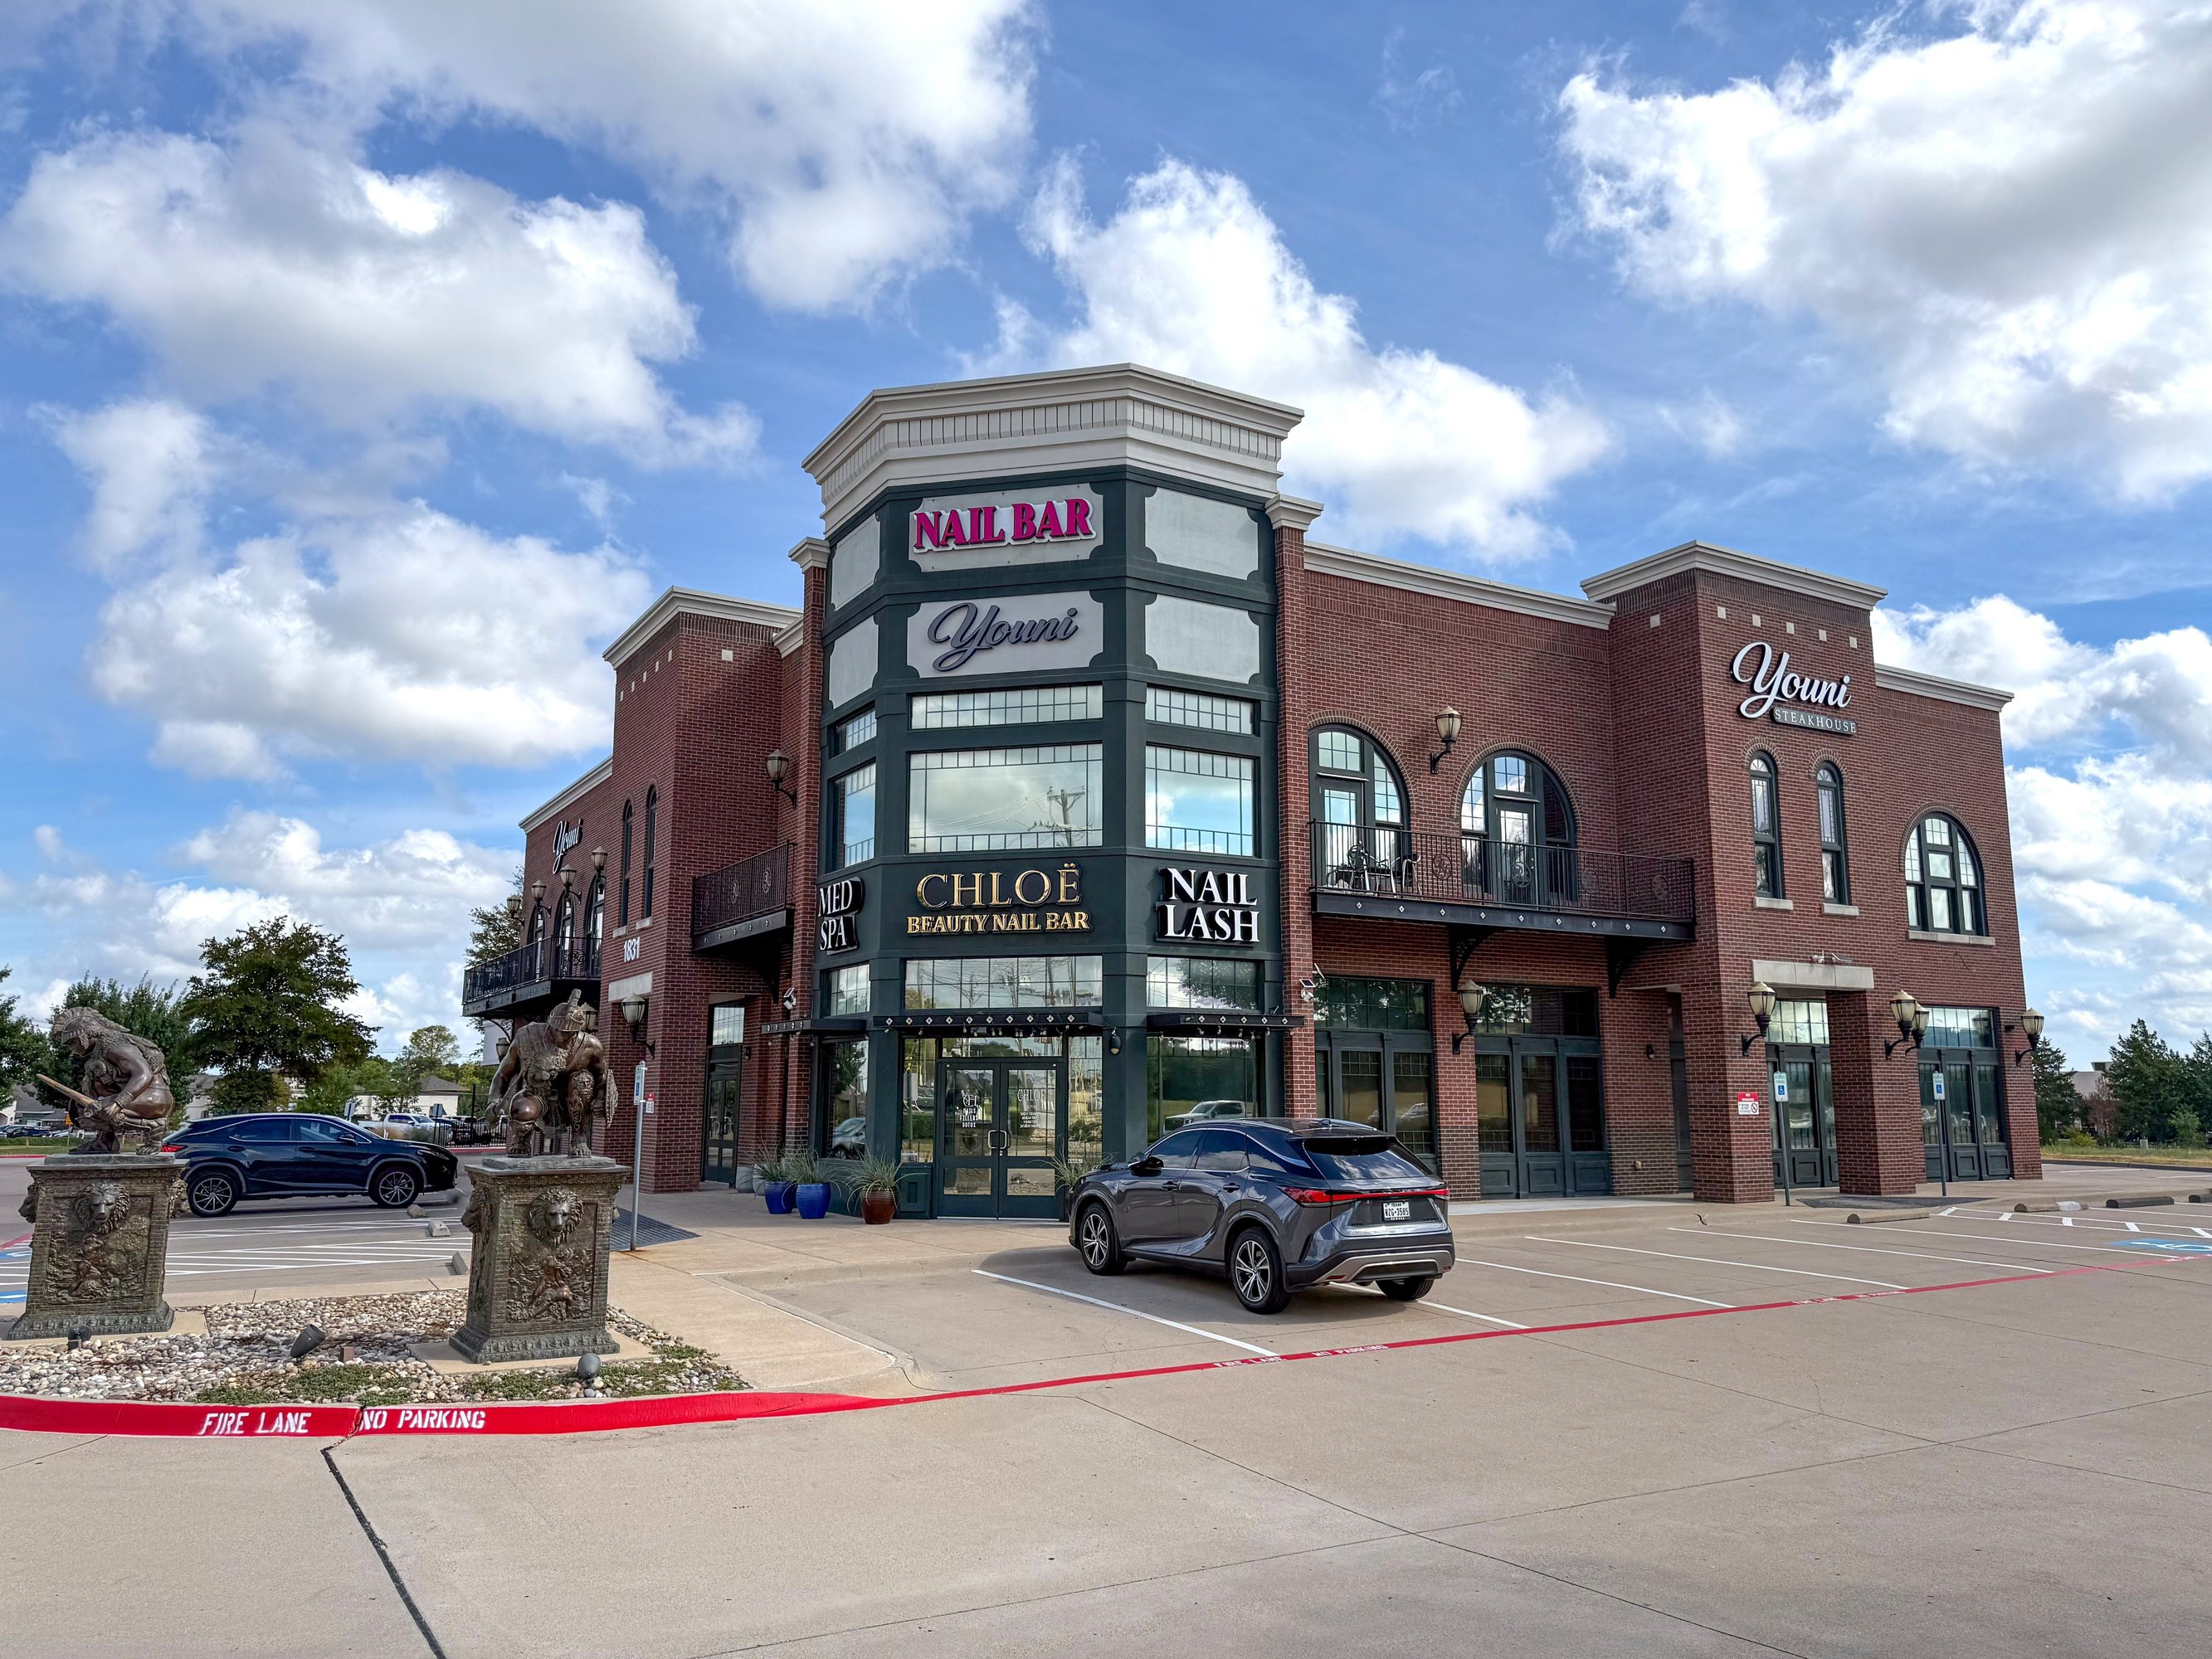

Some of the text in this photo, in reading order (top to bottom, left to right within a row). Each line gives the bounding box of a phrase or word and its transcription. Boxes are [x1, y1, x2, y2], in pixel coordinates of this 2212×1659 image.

[914, 499, 1094, 549] NAIL BAR
[927, 602, 1079, 672] Youni
[1732, 642, 1852, 718] Youni
[1775, 709, 1857, 733] STEAKHOUSE
[818, 879, 853, 917] MED
[916, 863, 1081, 909] CHLOË
[1167, 868, 1258, 906] NAIL
[820, 915, 847, 951] SPA
[907, 912, 1090, 934] BEAUTY NAIL BAR
[1164, 903, 1260, 942] LASH
[623, 937, 641, 962] 1831
[198, 1412, 312, 1435] FIRE LANE
[358, 1410, 486, 1430] NO PARKING
